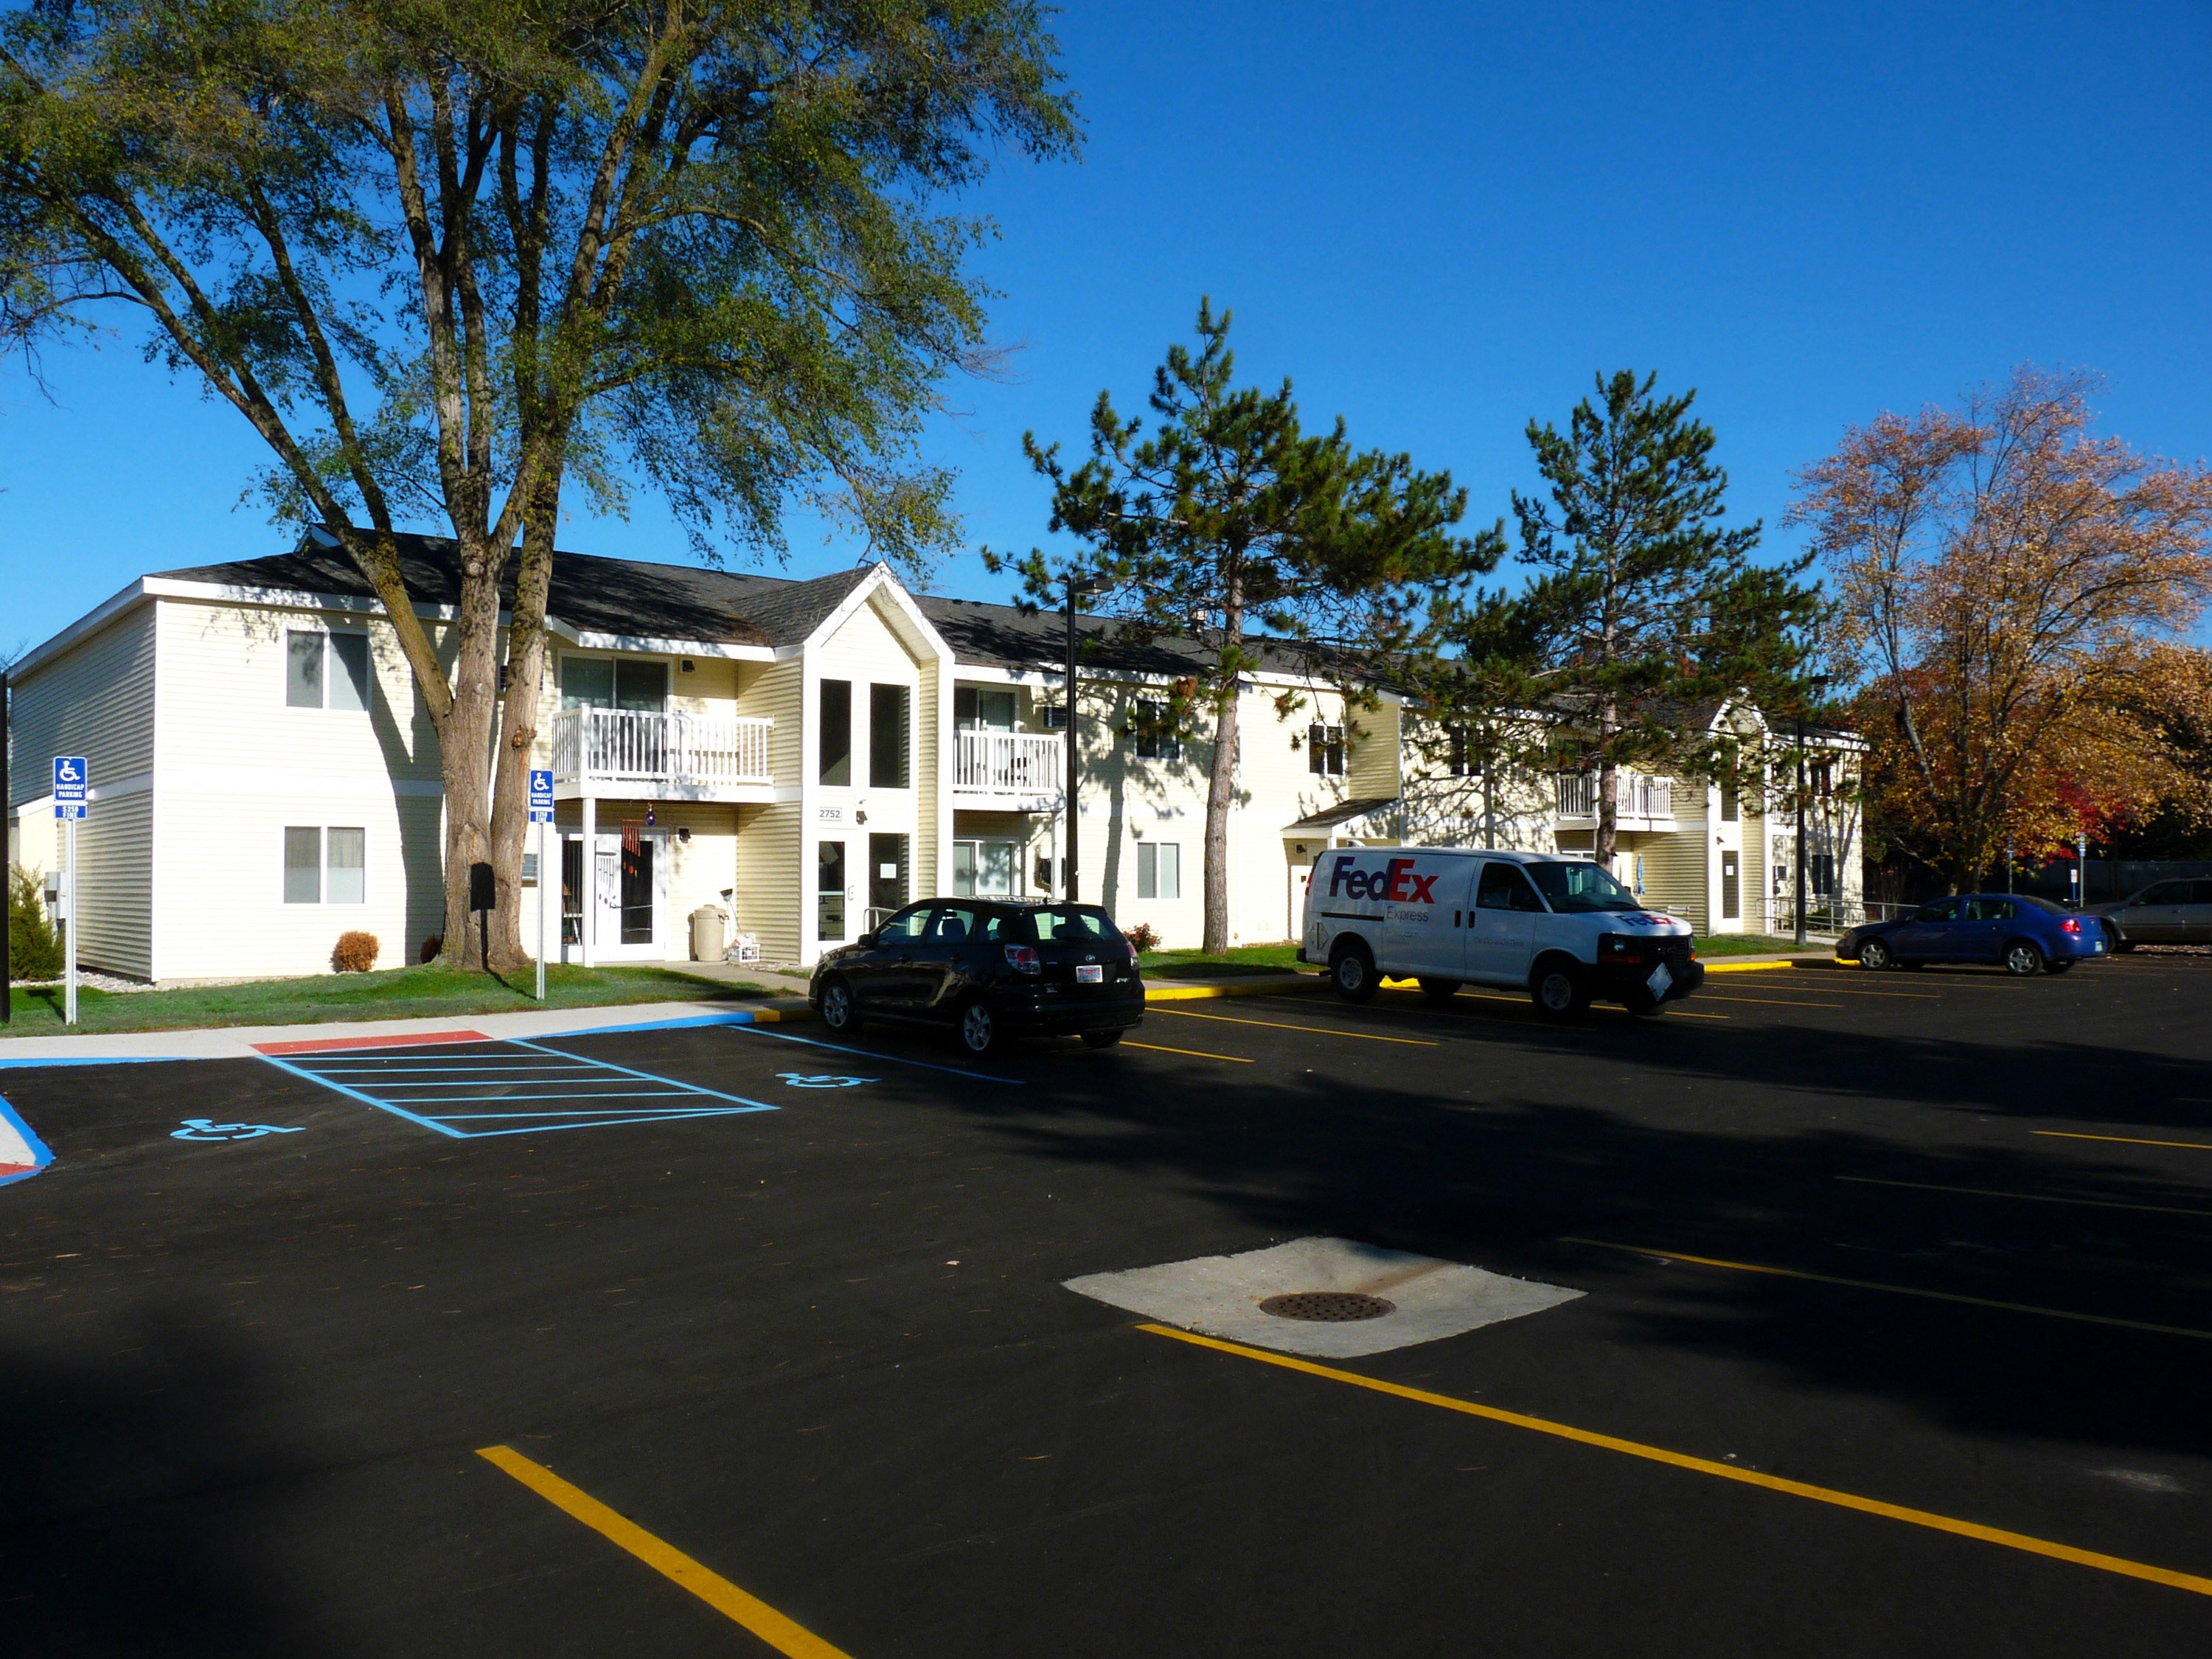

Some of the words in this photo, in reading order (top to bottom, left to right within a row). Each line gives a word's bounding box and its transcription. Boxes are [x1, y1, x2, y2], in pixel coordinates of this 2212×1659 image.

[819, 810, 841, 818] 2752
[1329, 856, 1440, 904] FedEx
[1386, 906, 1429, 922] Express
